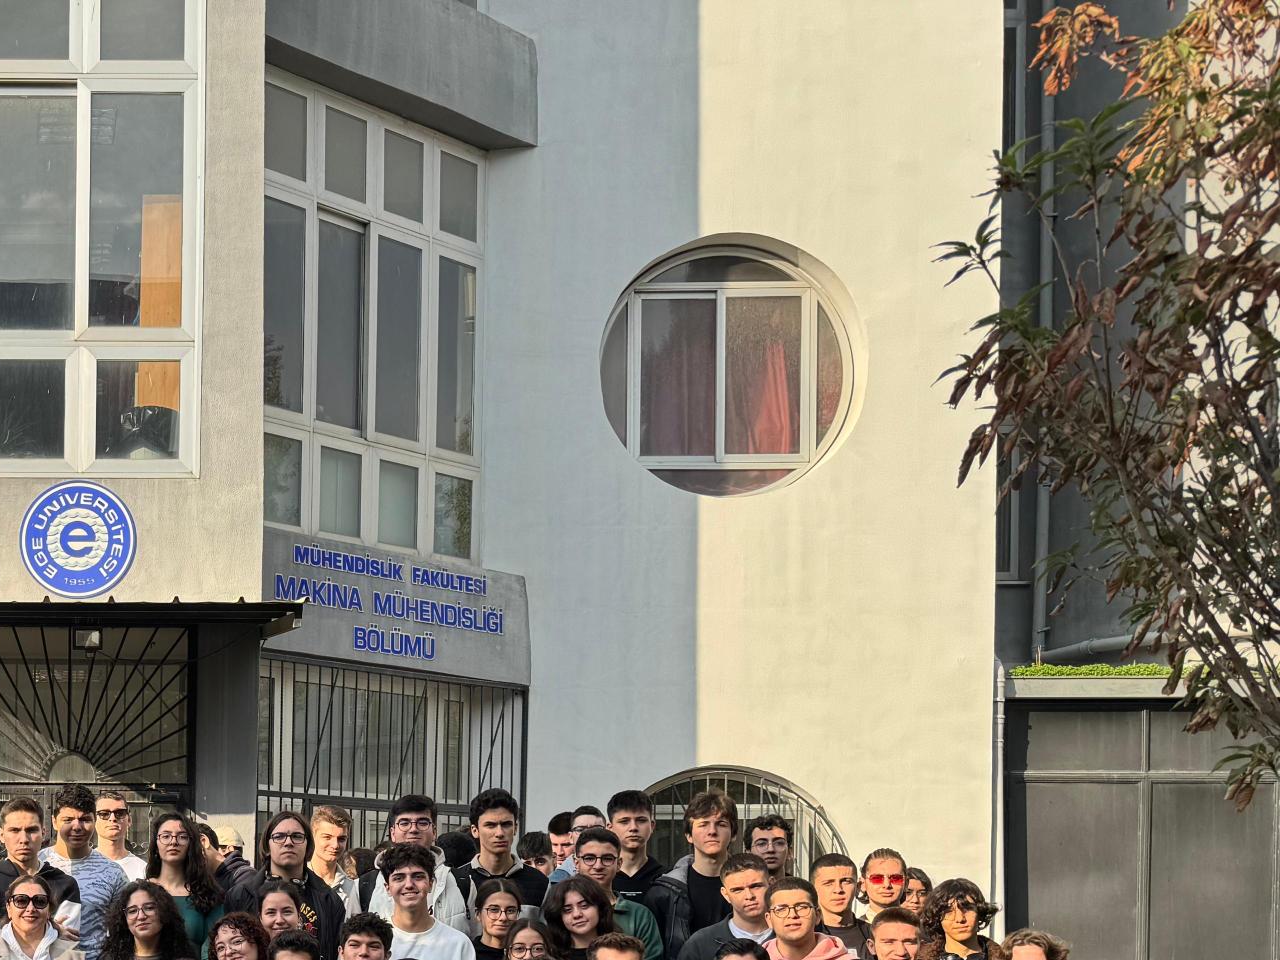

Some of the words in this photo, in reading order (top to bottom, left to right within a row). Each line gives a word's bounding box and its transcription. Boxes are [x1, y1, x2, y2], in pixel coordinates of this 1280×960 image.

[32, 537, 58, 579] EGE
[293, 544, 404, 582] MÜHENDİSLİK
[411, 567, 487, 596] FAKÜLTESİ
[274, 574, 364, 613] MAKİNA
[373, 591, 504, 635] MÜHENDİSLİĞİ
[352, 623, 436, 661] BÖLÜMÜ
